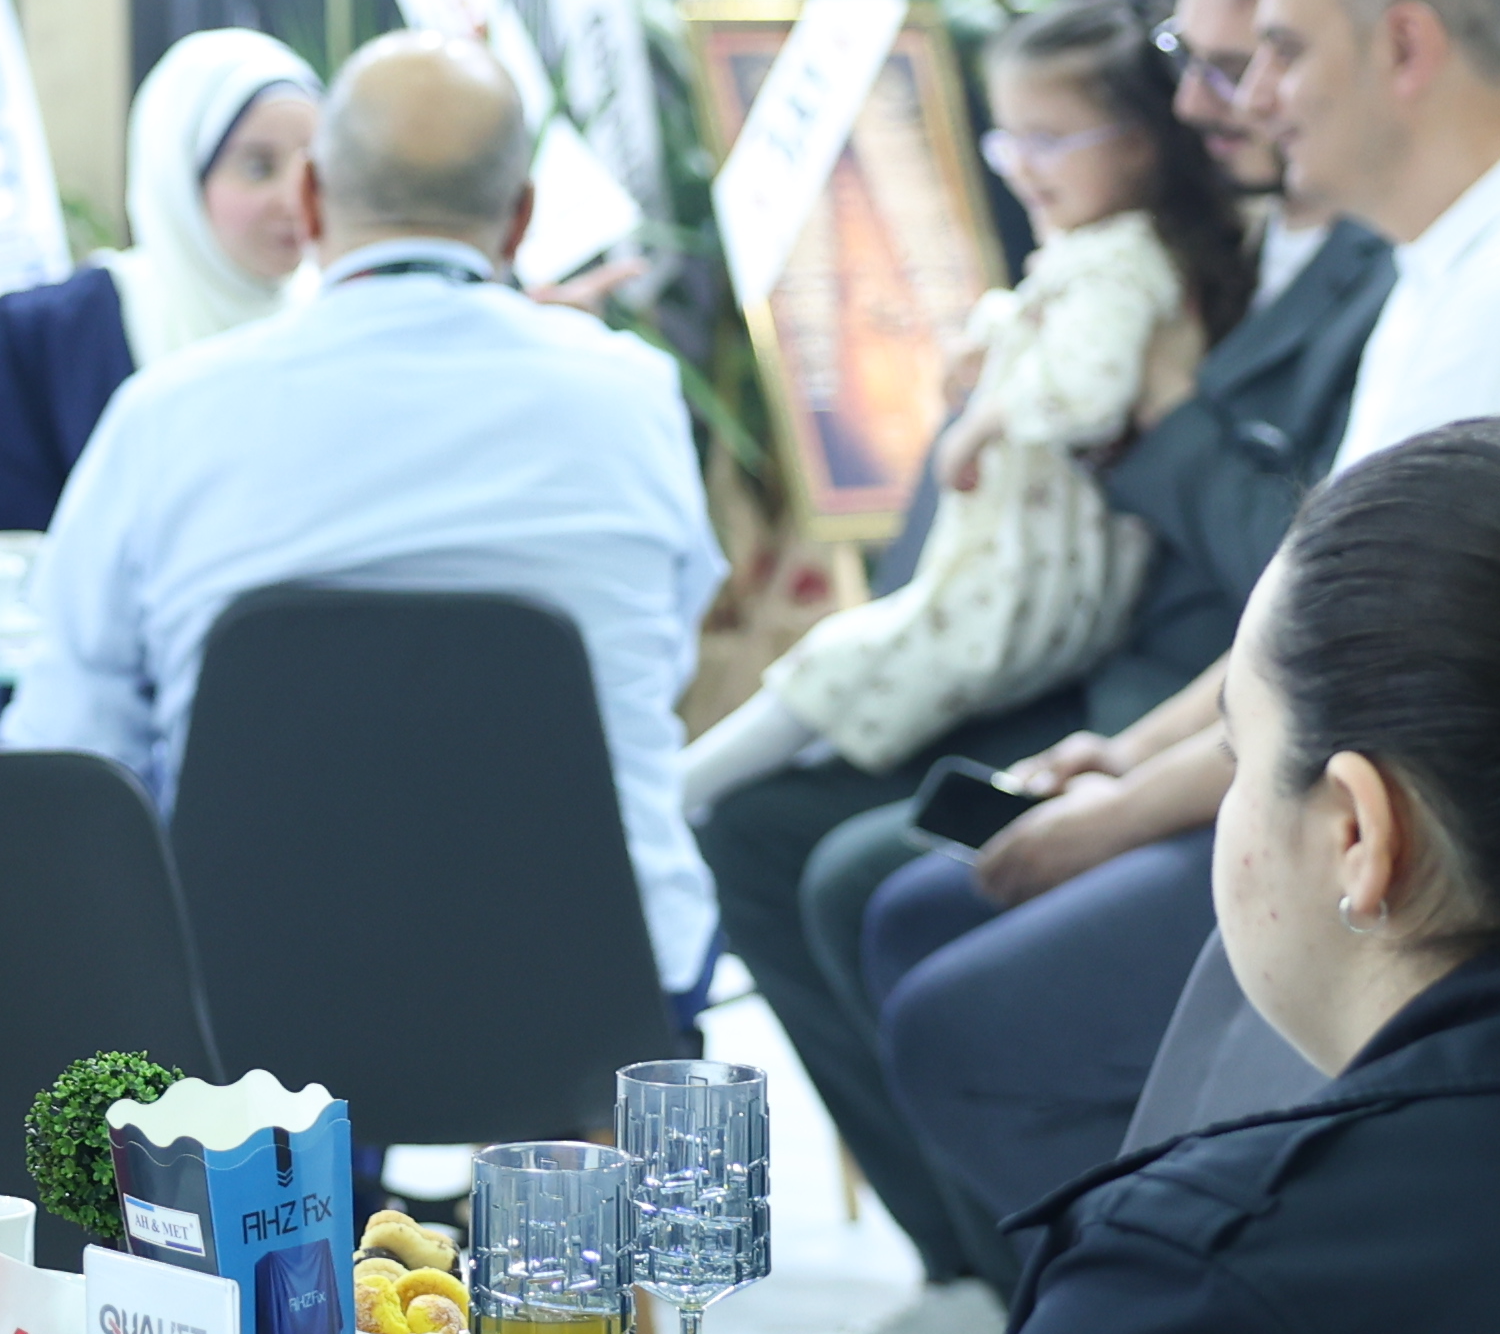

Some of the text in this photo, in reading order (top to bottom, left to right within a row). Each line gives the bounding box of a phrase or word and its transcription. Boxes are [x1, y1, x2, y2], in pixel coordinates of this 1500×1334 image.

[135, 1213, 150, 1231] AH
[151, 1219, 160, 1233] &
[242, 1193, 333, 1245] AHZ Fix
